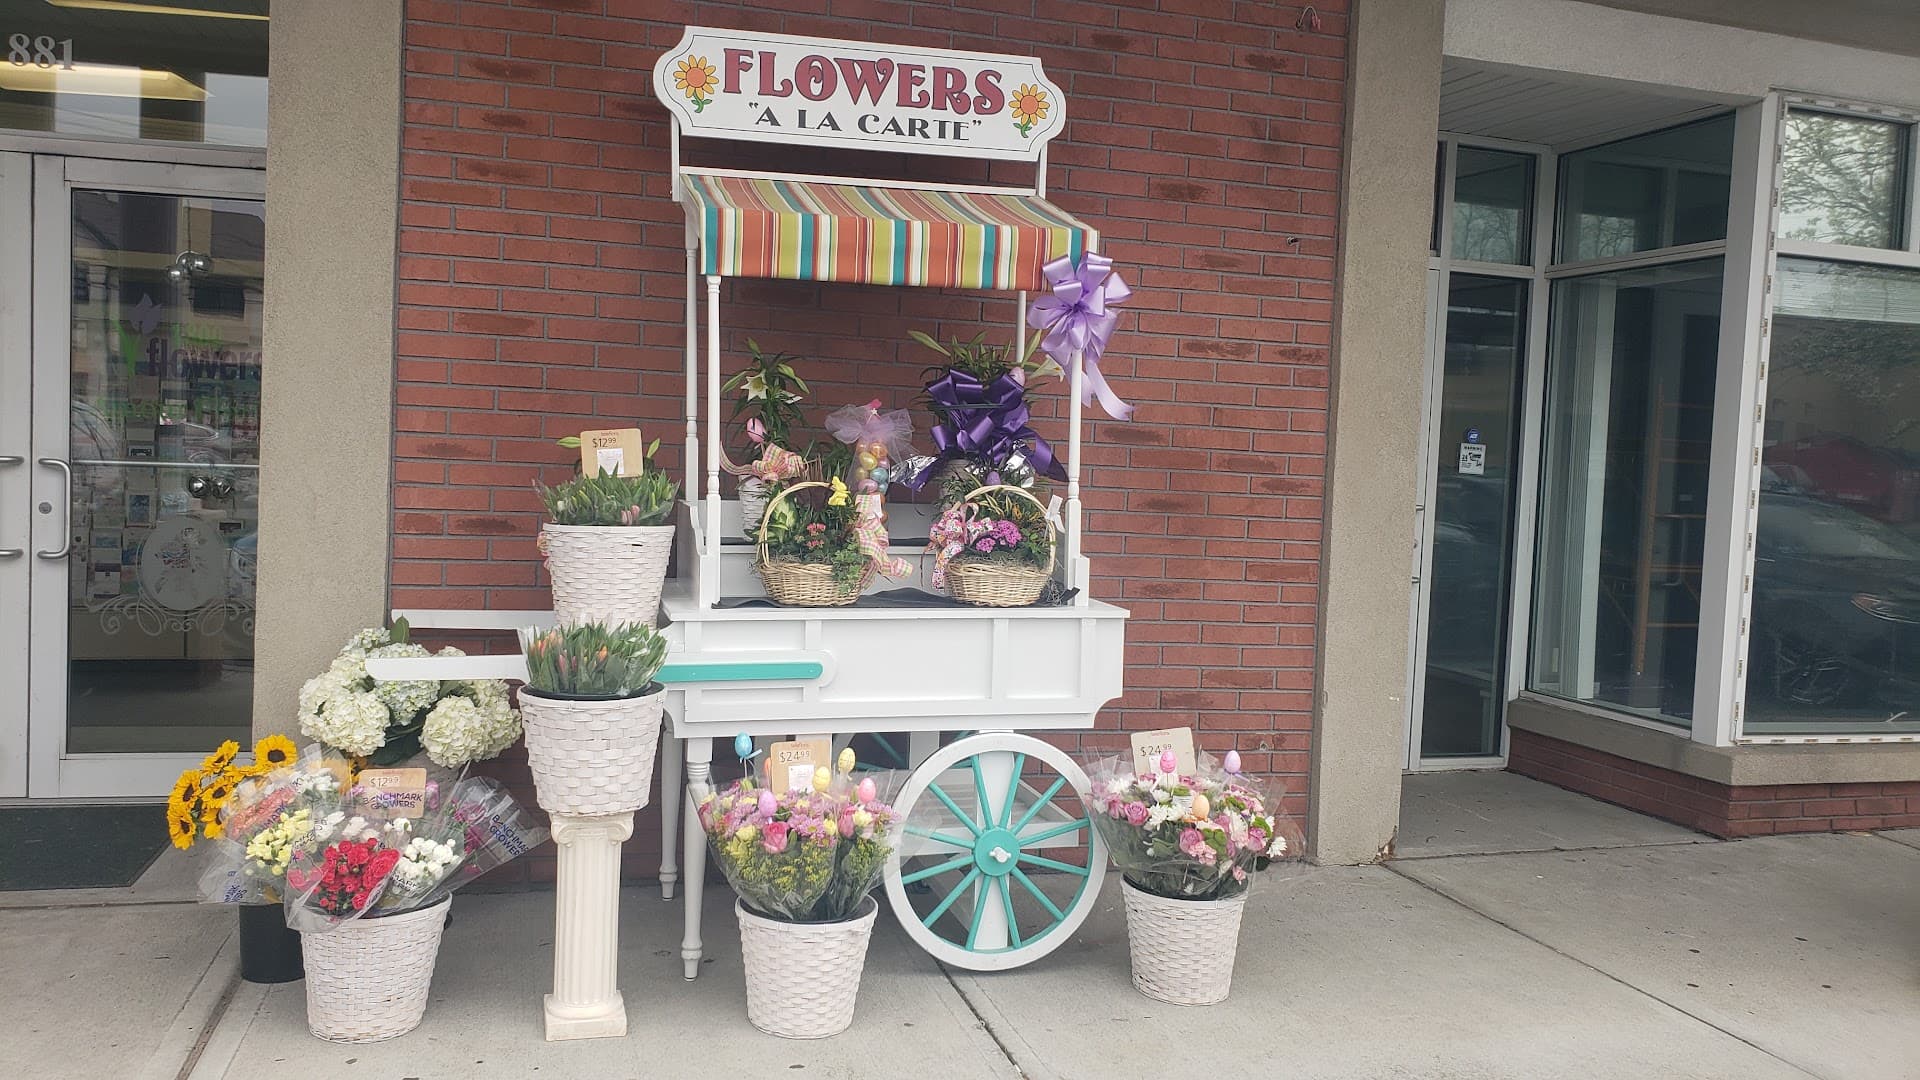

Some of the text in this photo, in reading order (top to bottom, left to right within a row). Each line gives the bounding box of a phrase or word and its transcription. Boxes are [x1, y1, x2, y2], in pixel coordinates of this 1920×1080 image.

[8, 33, 76, 71] 881
[723, 48, 1005, 116] FLOWERS
[797, 109, 842, 131] LA
